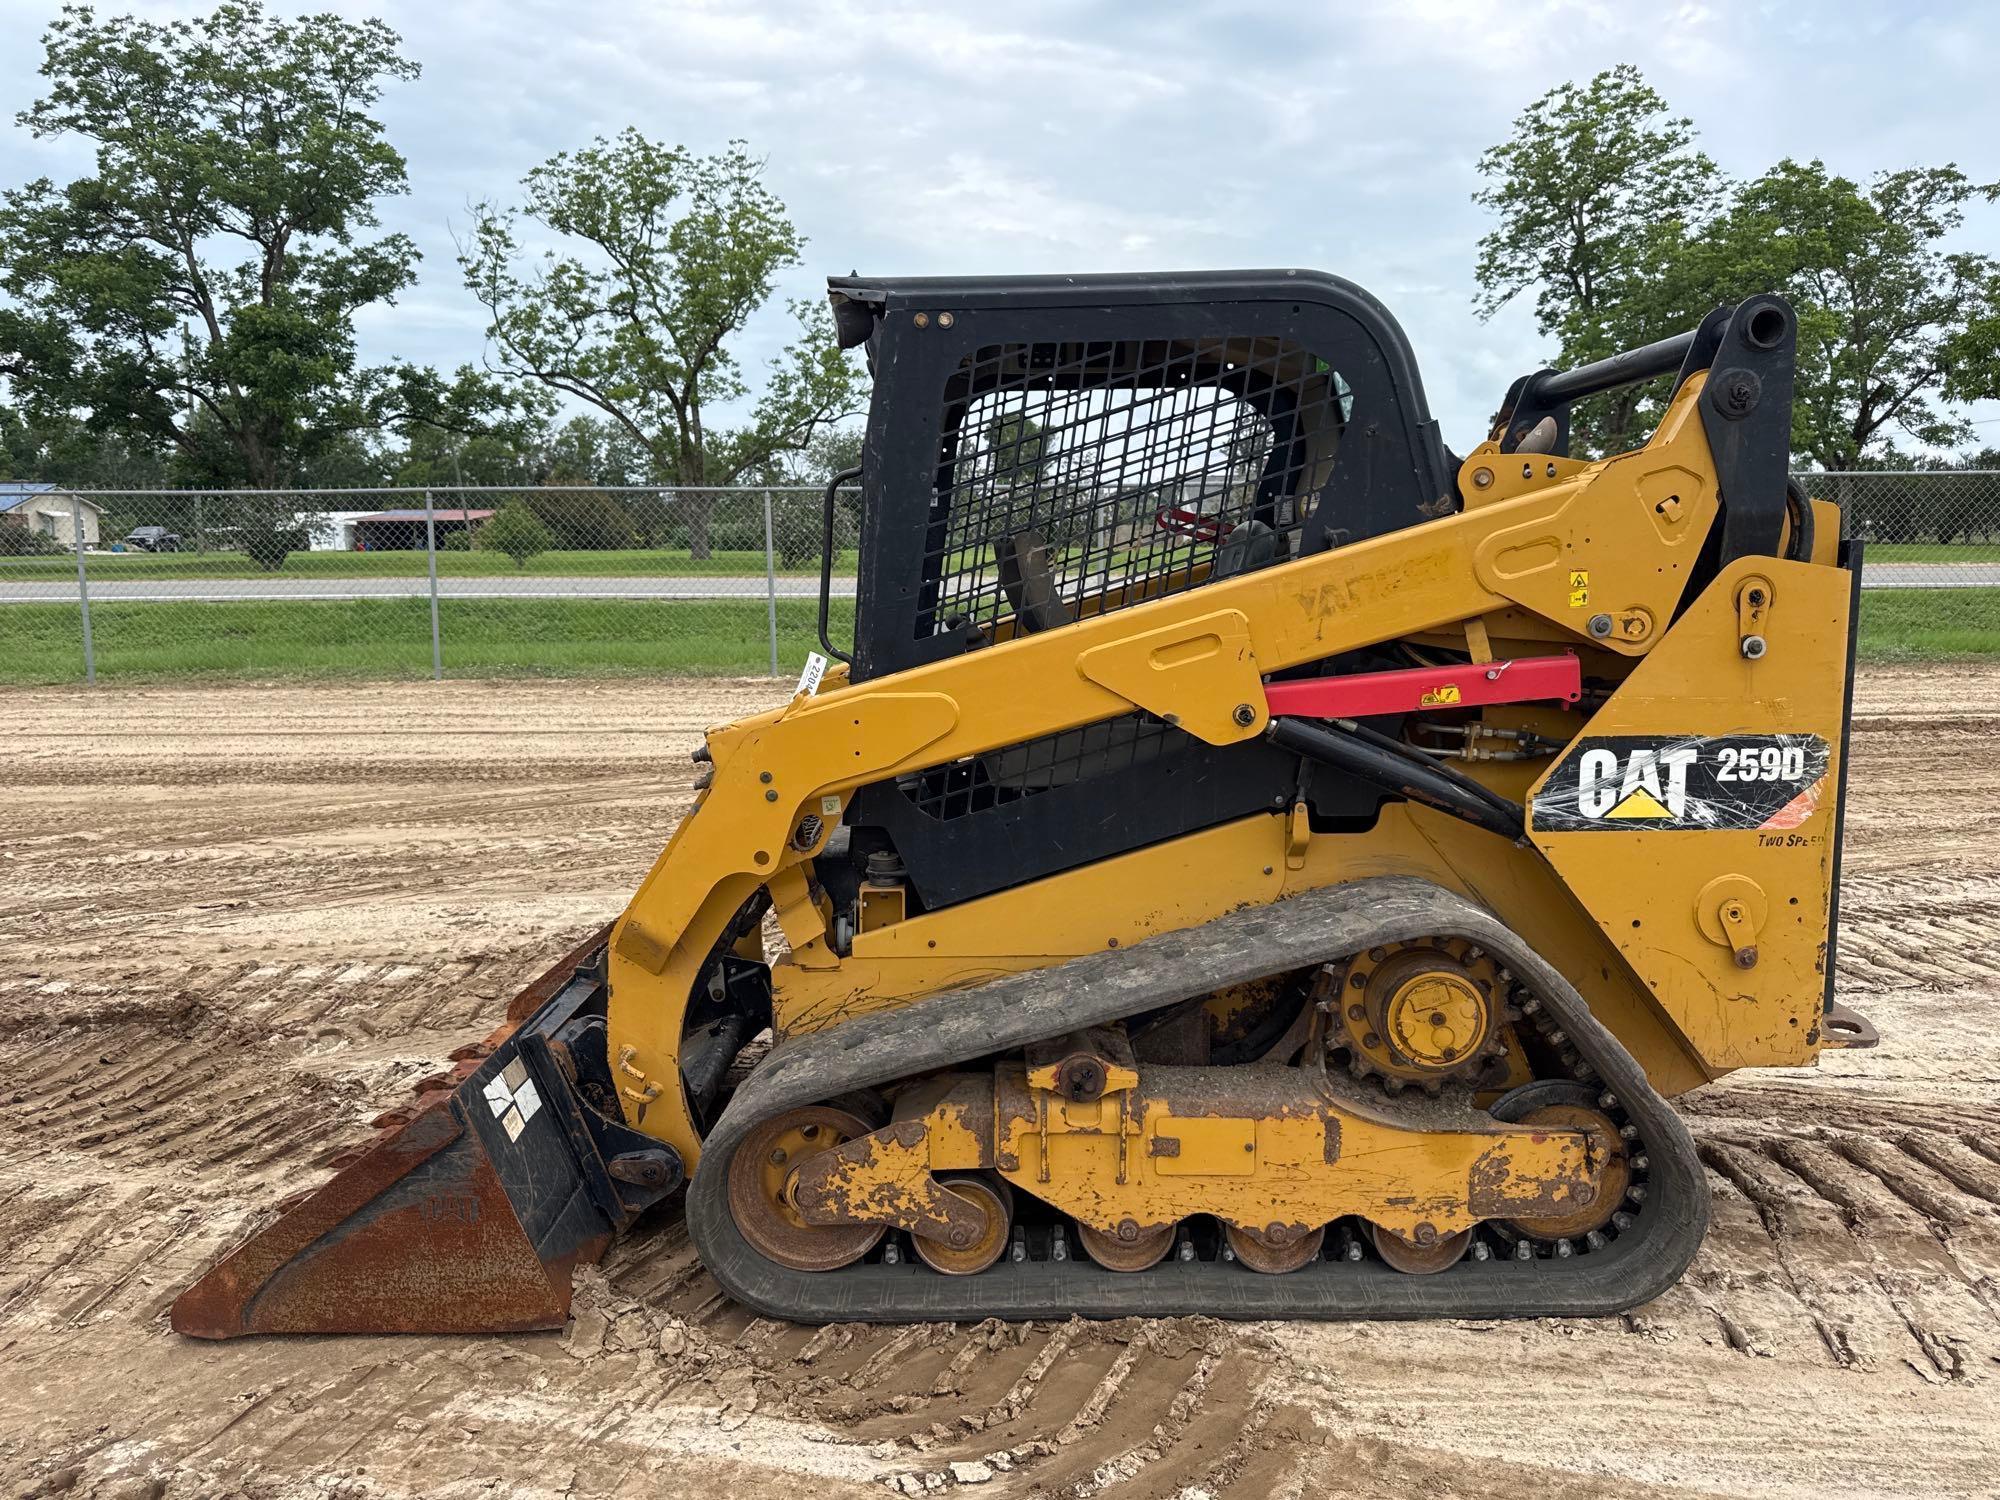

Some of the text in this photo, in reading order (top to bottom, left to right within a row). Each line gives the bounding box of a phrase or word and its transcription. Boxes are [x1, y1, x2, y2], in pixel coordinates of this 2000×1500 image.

[1578, 747, 1805, 819] CAT 259D
[1758, 834, 1784, 847] TWO
